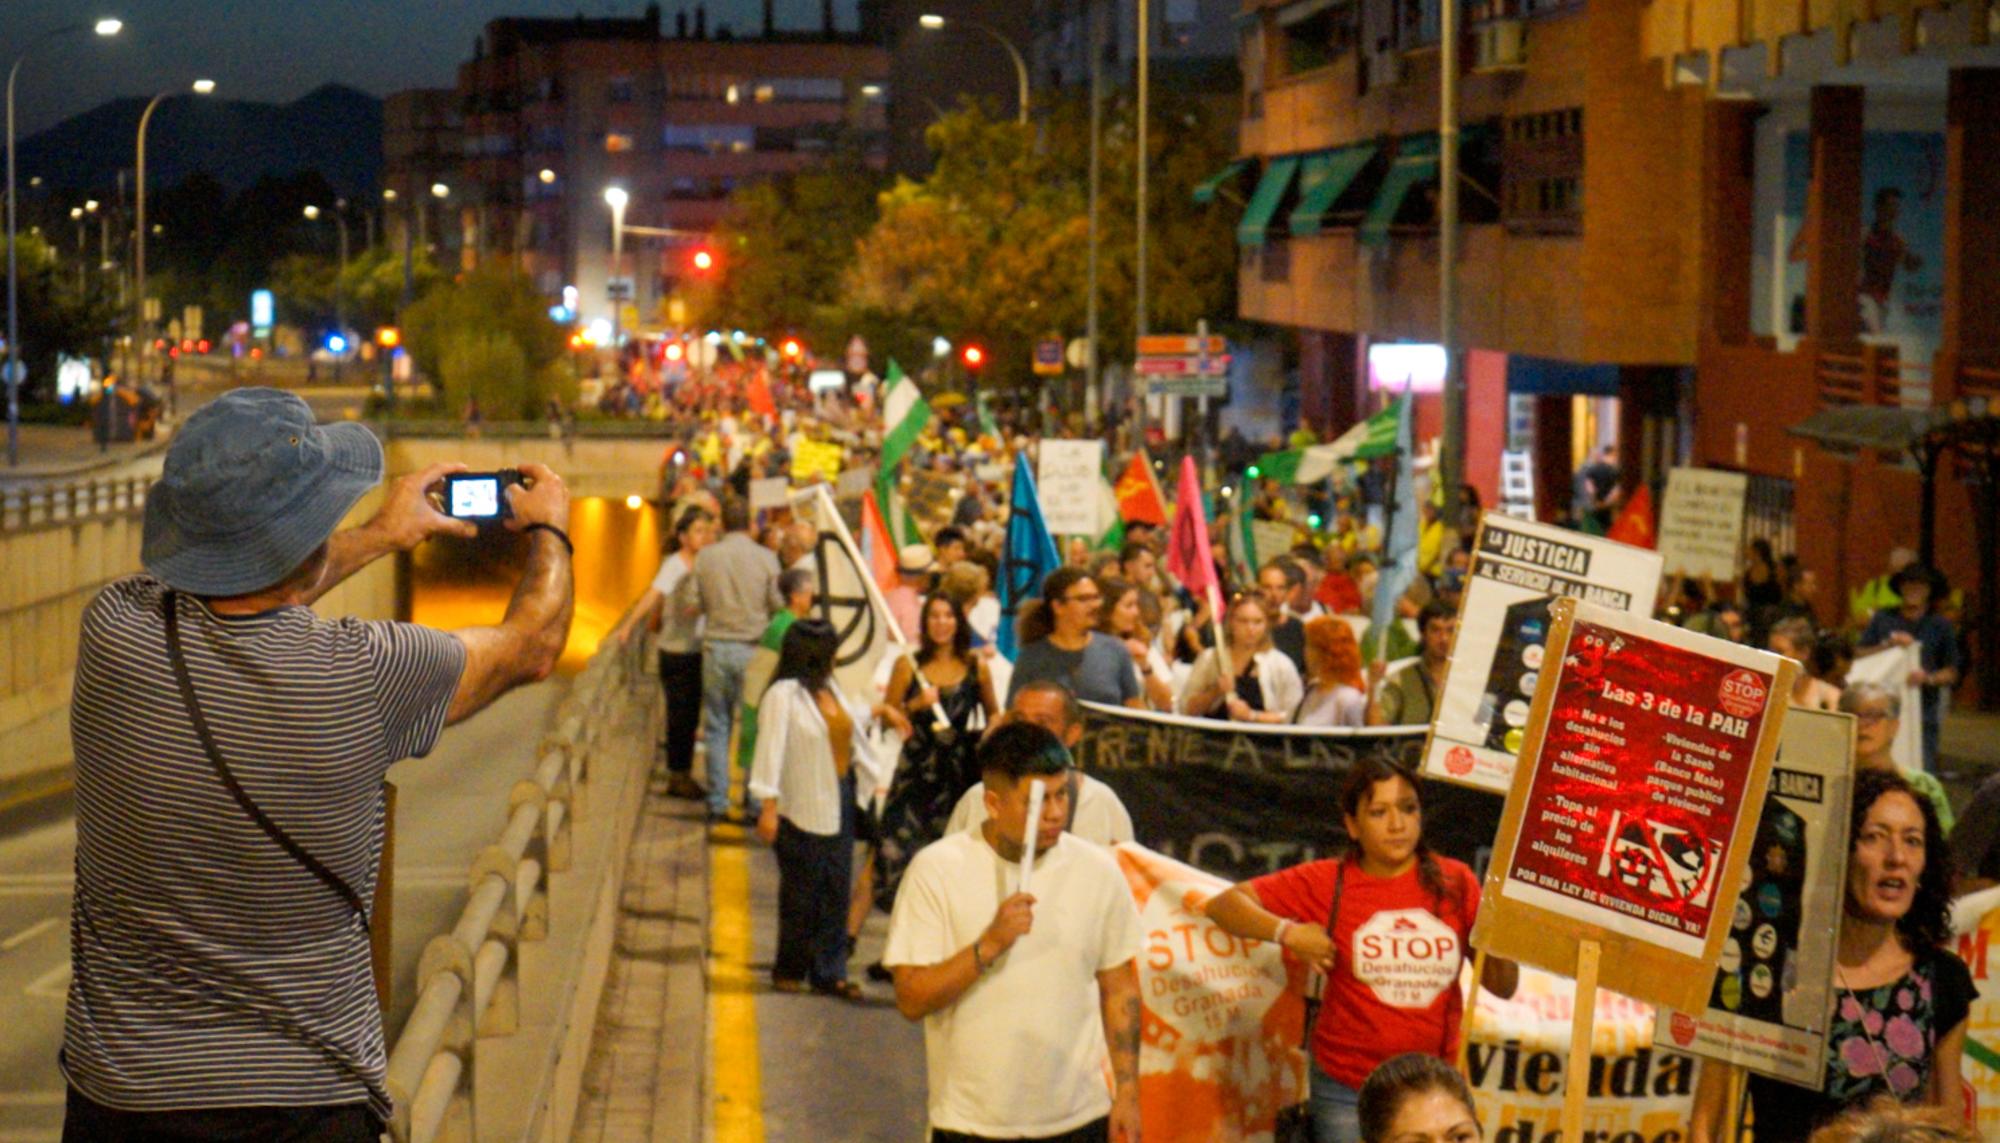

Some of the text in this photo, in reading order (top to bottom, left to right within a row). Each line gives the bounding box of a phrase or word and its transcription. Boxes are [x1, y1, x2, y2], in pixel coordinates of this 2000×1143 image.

[1488, 531, 1586, 574] LA JUSTICIA
[1496, 564, 1551, 593] SERVICIO
[1551, 579, 1568, 595] DE
[1569, 583, 1583, 599] LA
[1585, 585, 1628, 609] BANCA
[1724, 679, 1764, 700] STOP
[1581, 708, 1597, 721] No
[1608, 717, 1625, 731] los
[1602, 680, 1635, 706] Las
[1641, 692, 1655, 711] 3
[1658, 698, 1681, 720] de
[1686, 705, 1704, 726] la
[1709, 712, 1749, 738] PAH
[1565, 720, 1626, 746] desahucios
[1224, 735, 1264, 772] A
[1583, 742, 1601, 754] sin
[1671, 749, 1715, 771] la Sareb
[1718, 747, 1732, 760] de
[1560, 750, 1617, 775] alternativa
[1655, 760, 1725, 790] (Banco Malo)
[1552, 762, 1619, 791] habitacional
[1647, 775, 1684, 792] parque
[1780, 771, 1819, 800] BANCA
[1556, 795, 1583, 813] Tope
[1585, 805, 1598, 818] al
[1652, 790, 1712, 817] de vivienda
[1541, 810, 1595, 834] precio de
[1555, 829, 1573, 844] los
[1532, 840, 1589, 866] alquileres
[1516, 867, 1537, 883] POR
[1538, 873, 1560, 890] UNA
[1561, 881, 1582, 897] LEY
[1583, 888, 1597, 902] DE
[1598, 893, 1647, 918] VIVIENDA
[1148, 923, 1262, 972] STOP
[1362, 934, 1454, 960] STOP
[1362, 961, 1453, 976] Desahucios
[1374, 976, 1439, 989] Granada
[1173, 983, 1263, 1017] Granada
